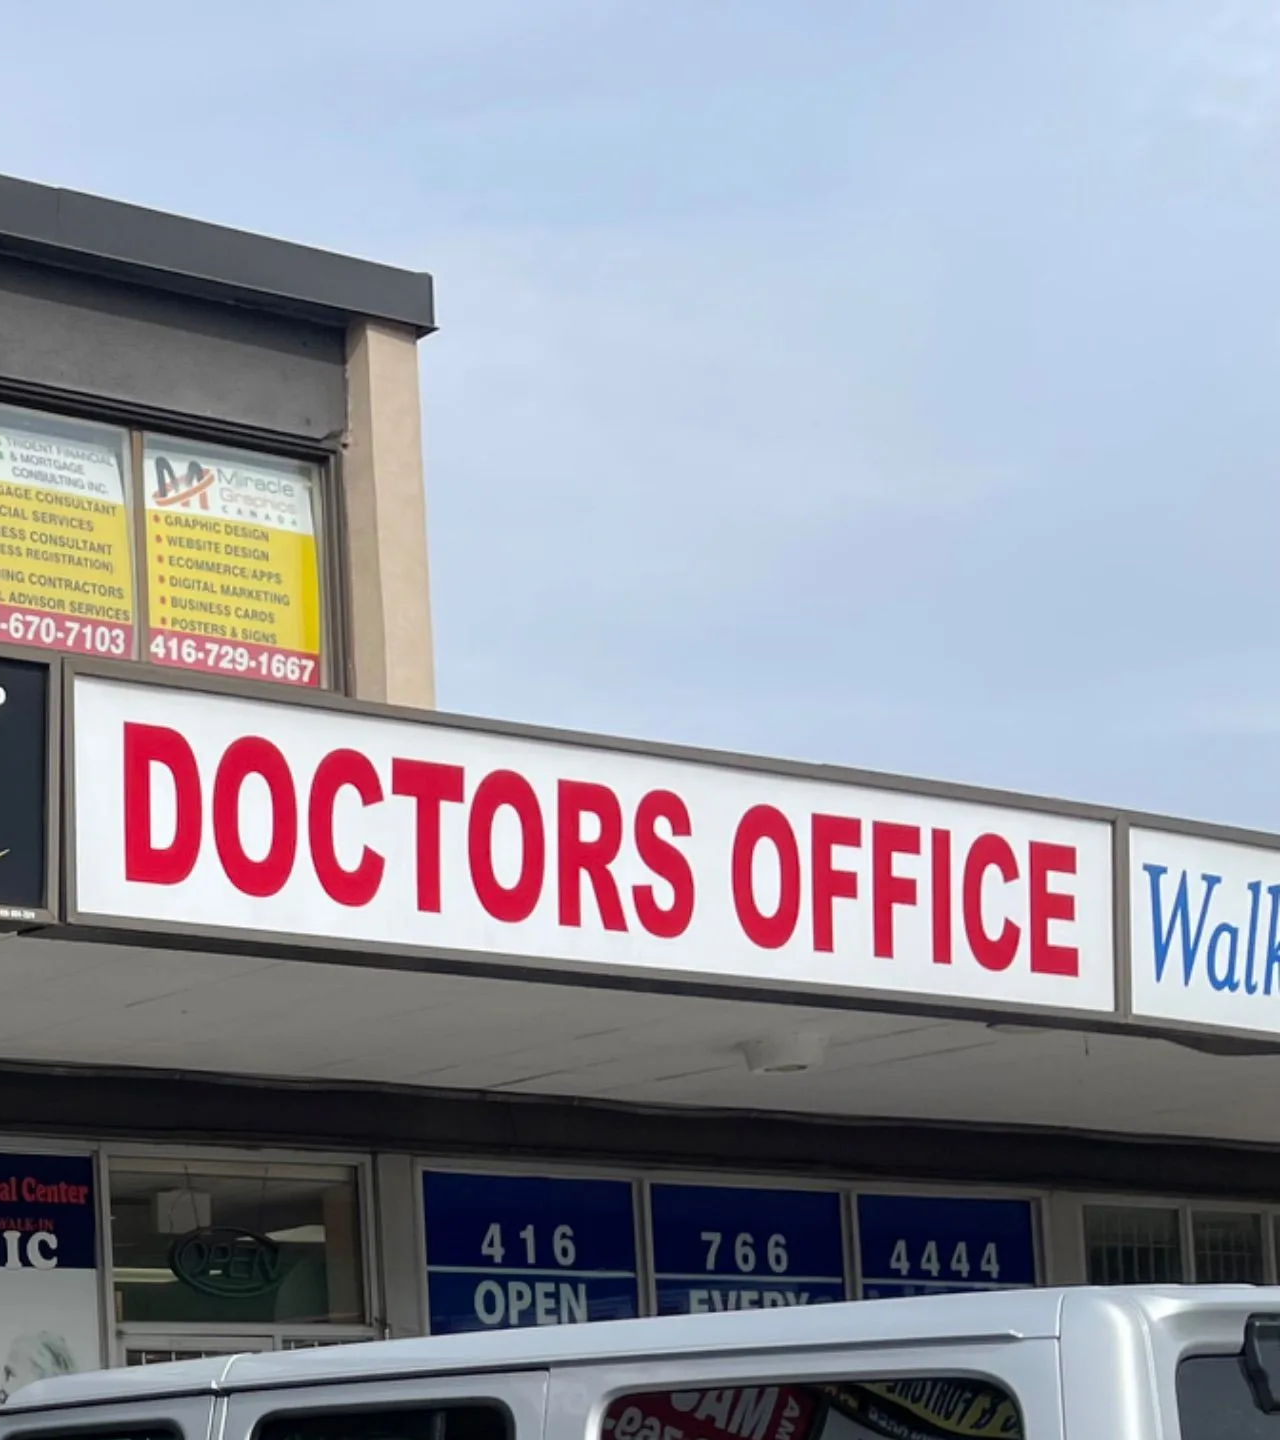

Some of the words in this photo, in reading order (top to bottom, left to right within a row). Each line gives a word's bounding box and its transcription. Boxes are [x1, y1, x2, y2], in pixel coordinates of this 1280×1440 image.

[35, 491, 116, 517] CONSULTANT
[32, 510, 94, 532] SERVICES
[165, 515, 221, 534] GRAPHIC
[224, 523, 269, 542] DESIGN
[30, 531, 112, 555] CONSULTANT
[166, 535, 221, 554] WEBSITE
[224, 544, 269, 562] DESIGN
[26, 548, 113, 575] REGISTRATION)
[28, 573, 124, 599] CONTRACTORS
[169, 576, 216, 594] DIGITAL
[220, 584, 290, 606] MARKETING
[9, 591, 65, 611] ADVISOR
[69, 601, 130, 621] SERVICES
[170, 597, 231, 617] BUSINESS
[234, 606, 275, 624] CARDS
[171, 617, 226, 637] POSTERS
[241, 628, 277, 645] SIGNS
[150, 635, 315, 682] 416-729-1667
[122, 720, 696, 941] DOCTORS
[731, 802, 1080, 979] OFFICE
[22, 1179, 88, 1206] Center
[481, 1223, 576, 1266] 416
[700, 1232, 788, 1274] 766
[890, 1239, 1000, 1279] 4444
[475, 1280, 587, 1326] OPEN
